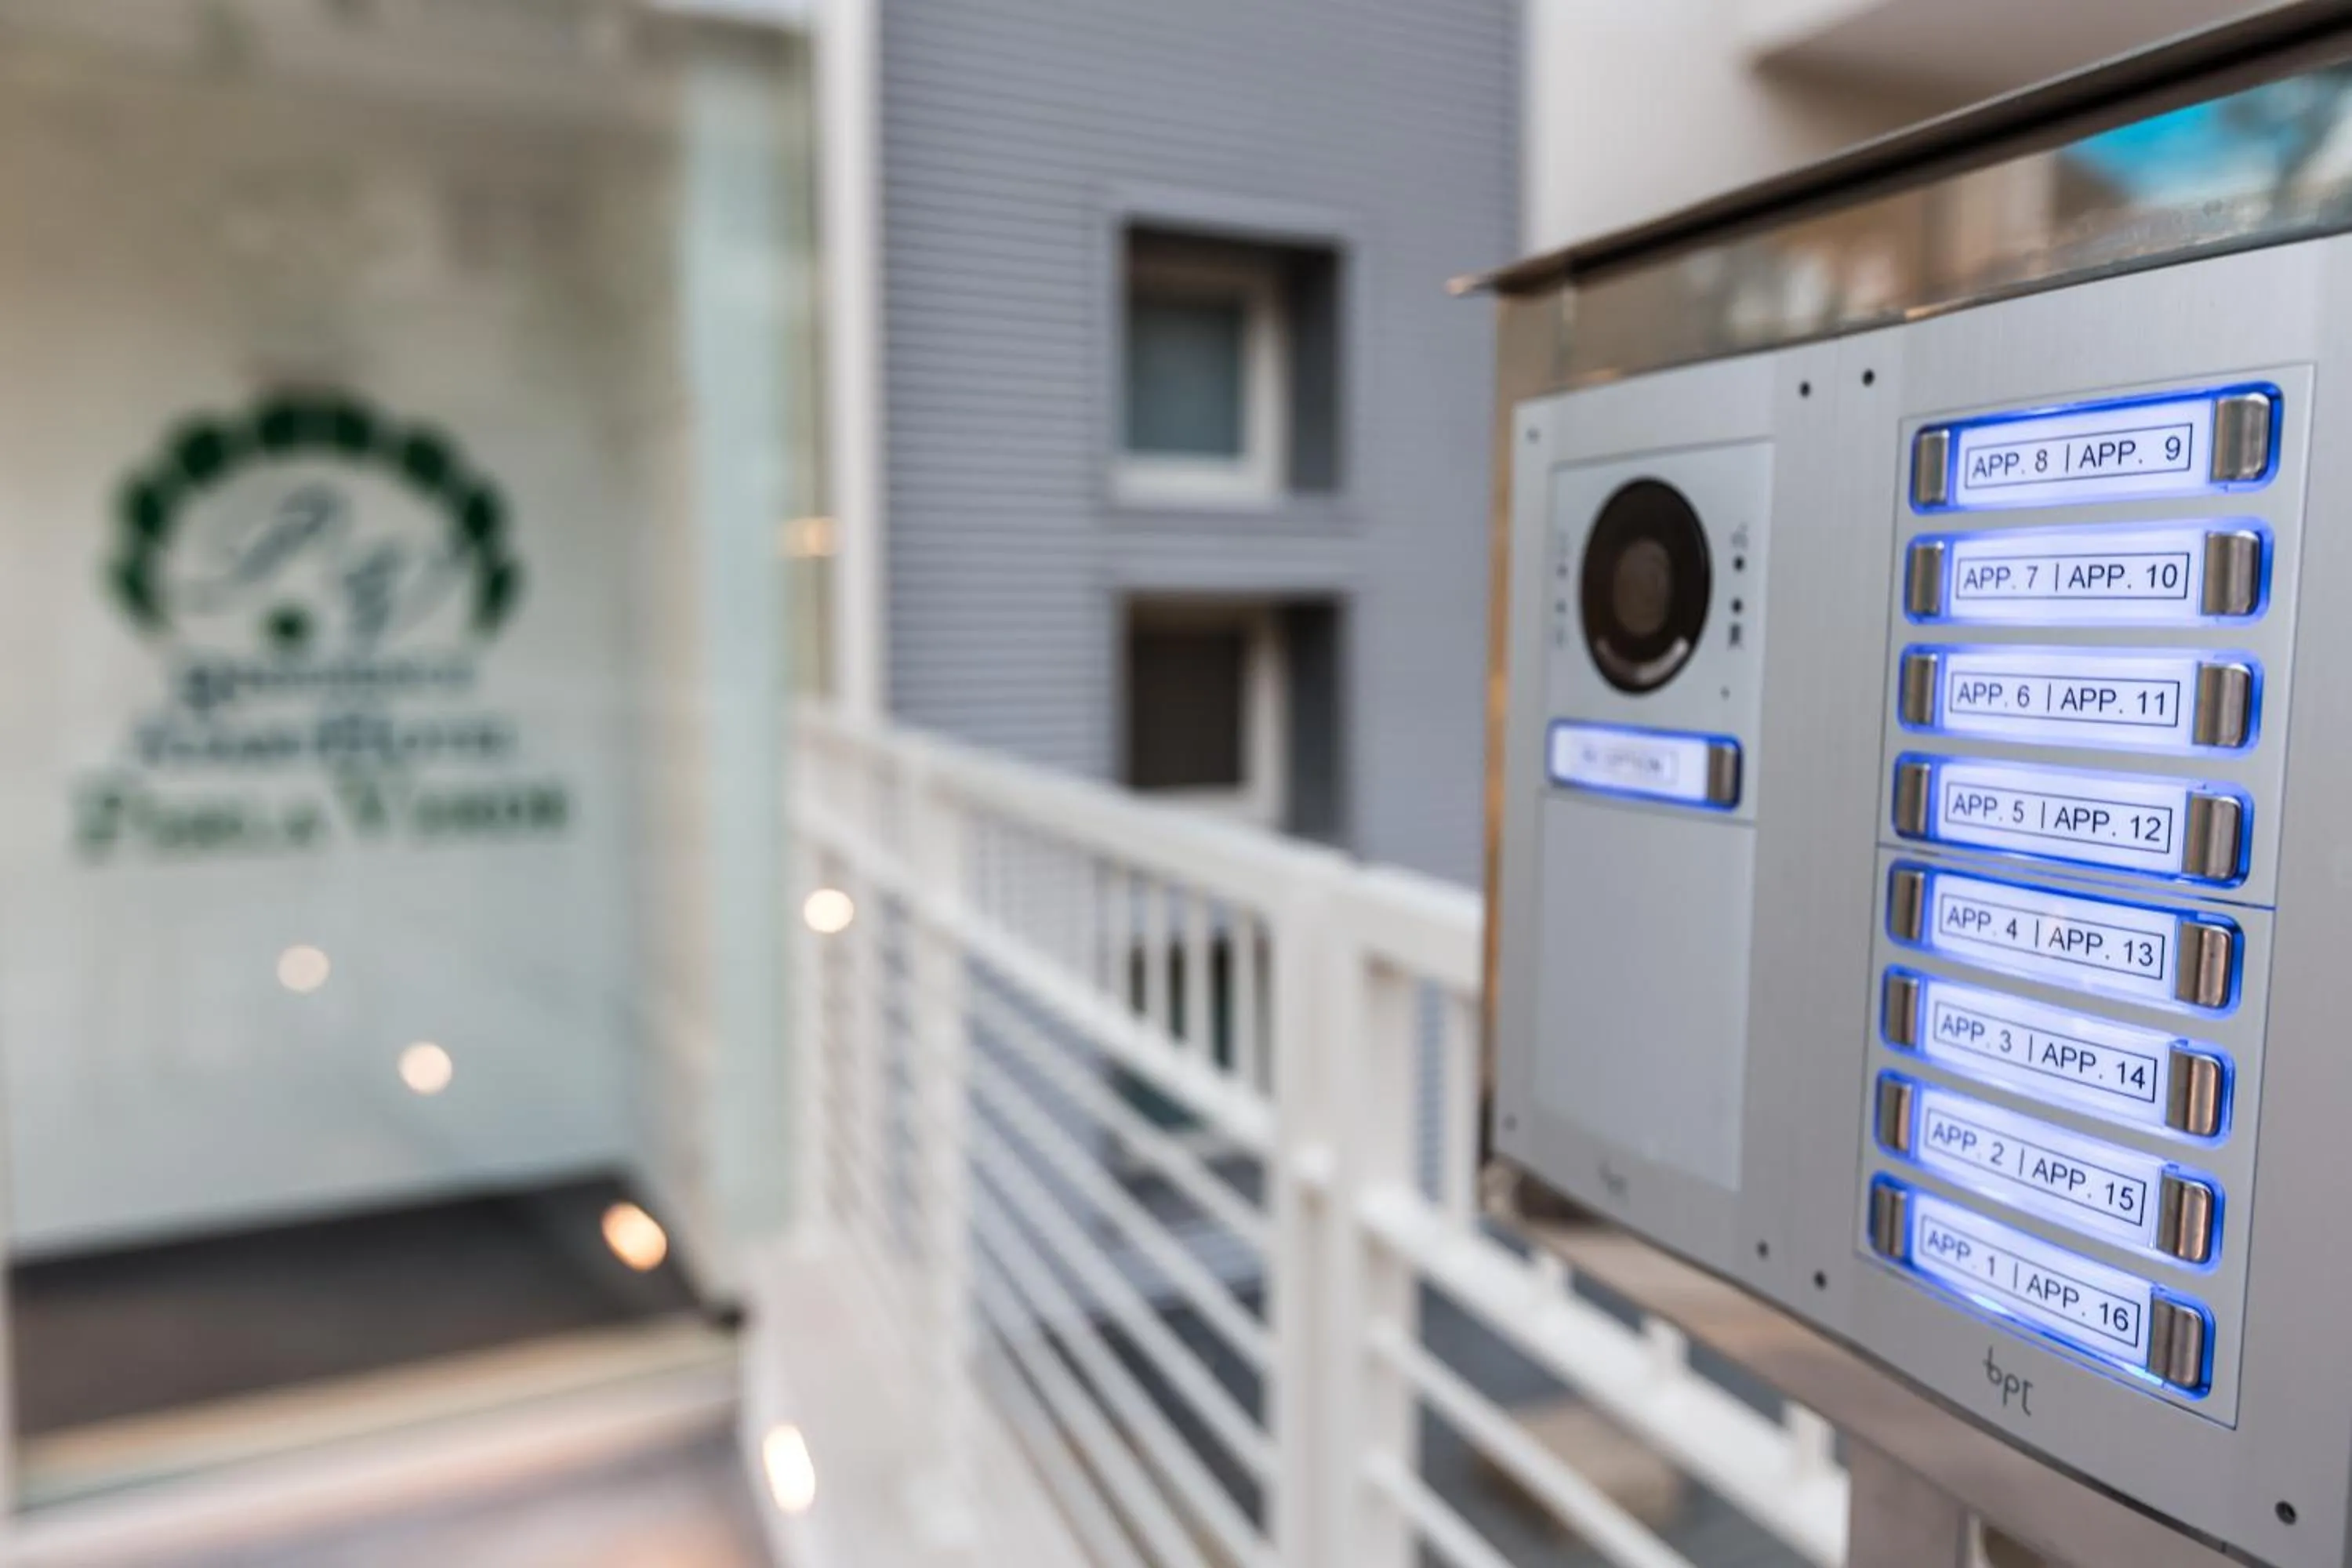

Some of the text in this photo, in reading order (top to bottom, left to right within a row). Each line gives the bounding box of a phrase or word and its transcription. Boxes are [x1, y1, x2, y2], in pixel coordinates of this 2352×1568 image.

[1972, 452, 2026, 479] APP.
[2034, 448, 2049, 473] 8
[2078, 439, 2144, 470] APP.
[2165, 434, 2182, 462] 9
[1963, 566, 2016, 590] APP.
[2026, 566, 2039, 589] 7
[2067, 564, 2133, 590] APP.
[2146, 563, 2178, 588] 10
[1957, 682, 2009, 707] APP.
[2016, 684, 2031, 707] 6
[2060, 686, 2124, 715] APP.
[2136, 688, 2166, 716] 11
[1951, 793, 2004, 822] APP.
[2012, 800, 2024, 823] 5
[2054, 806, 2117, 837] APP.
[2129, 815, 2161, 841] 12
[1946, 905, 1998, 937] APP.
[2006, 917, 2018, 941] 4
[2048, 927, 2111, 960] APP.
[2123, 940, 2154, 967] 13
[1940, 1013, 1991, 1047] APP.
[1999, 1029, 2013, 1054] 3
[2042, 1041, 2104, 1079] APP.
[2116, 1062, 2147, 1090] 14
[1931, 1120, 1982, 1159] APP.
[1991, 1142, 2005, 1166] 2
[2031, 1160, 2092, 1200] APP.
[2105, 1181, 2135, 1211] 15
[1926, 1229, 1977, 1269] APP.
[1987, 1254, 1997, 1277] 1
[2026, 1274, 2086, 1317] APP.
[2098, 1301, 2129, 1332] 16
